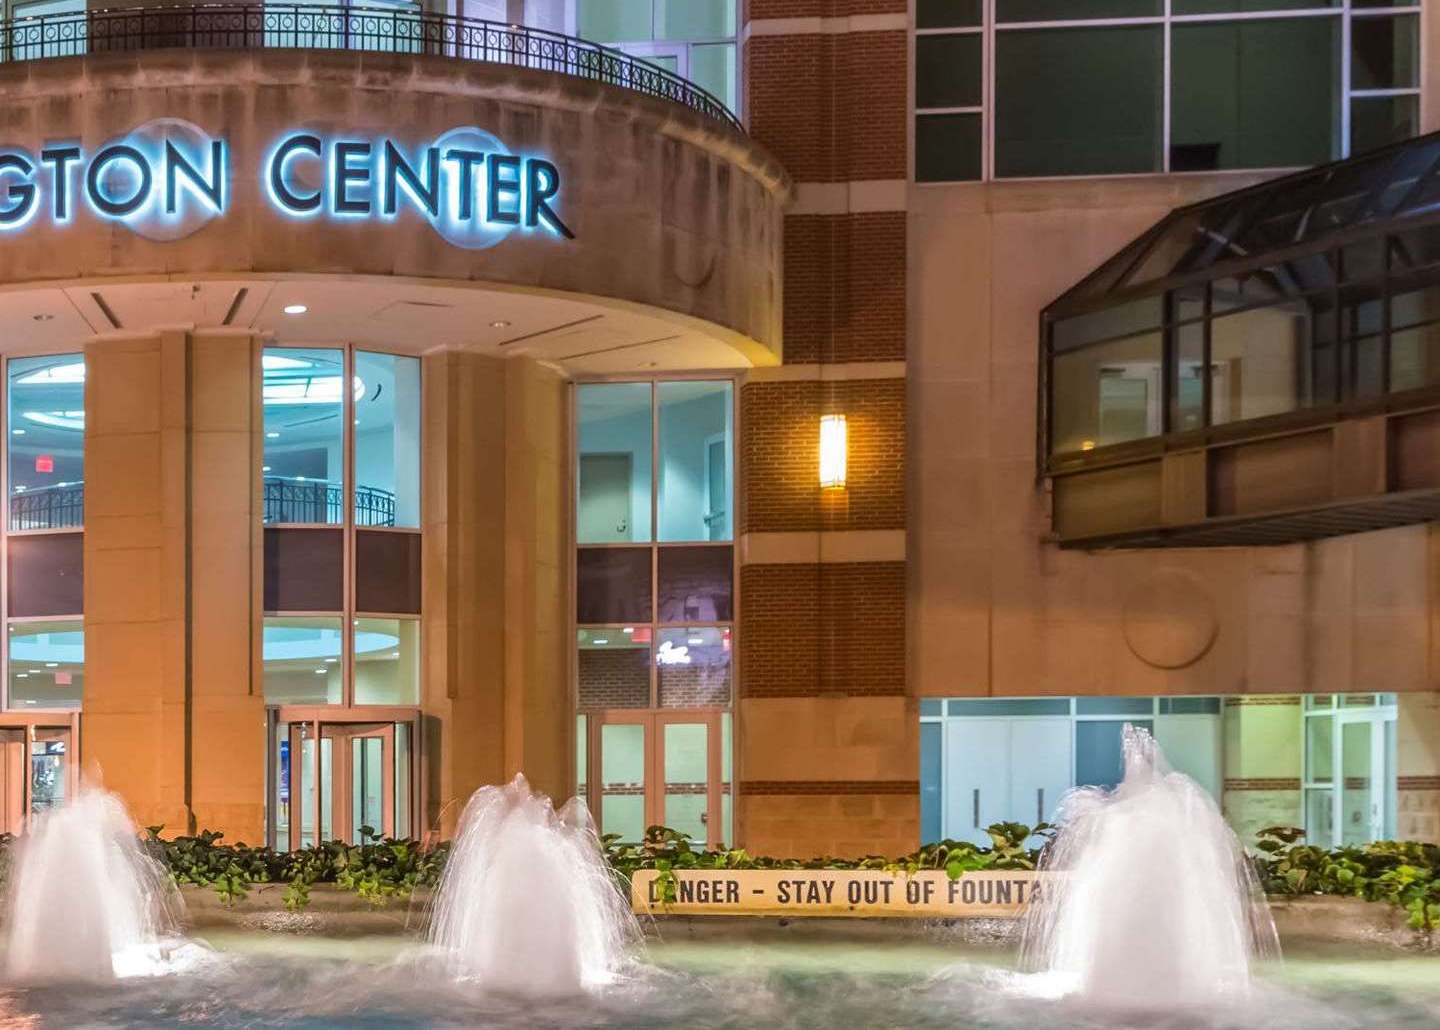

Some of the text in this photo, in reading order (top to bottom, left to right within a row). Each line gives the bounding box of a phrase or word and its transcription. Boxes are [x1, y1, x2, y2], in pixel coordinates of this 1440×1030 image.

[270, 135, 576, 240] CENTER
[648, 880, 740, 904] DNGER
[777, 880, 836, 904] STAY
[848, 880, 895, 904] OUT
[906, 880, 936, 904] OF
[948, 880, 1048, 904] FOUNTA
